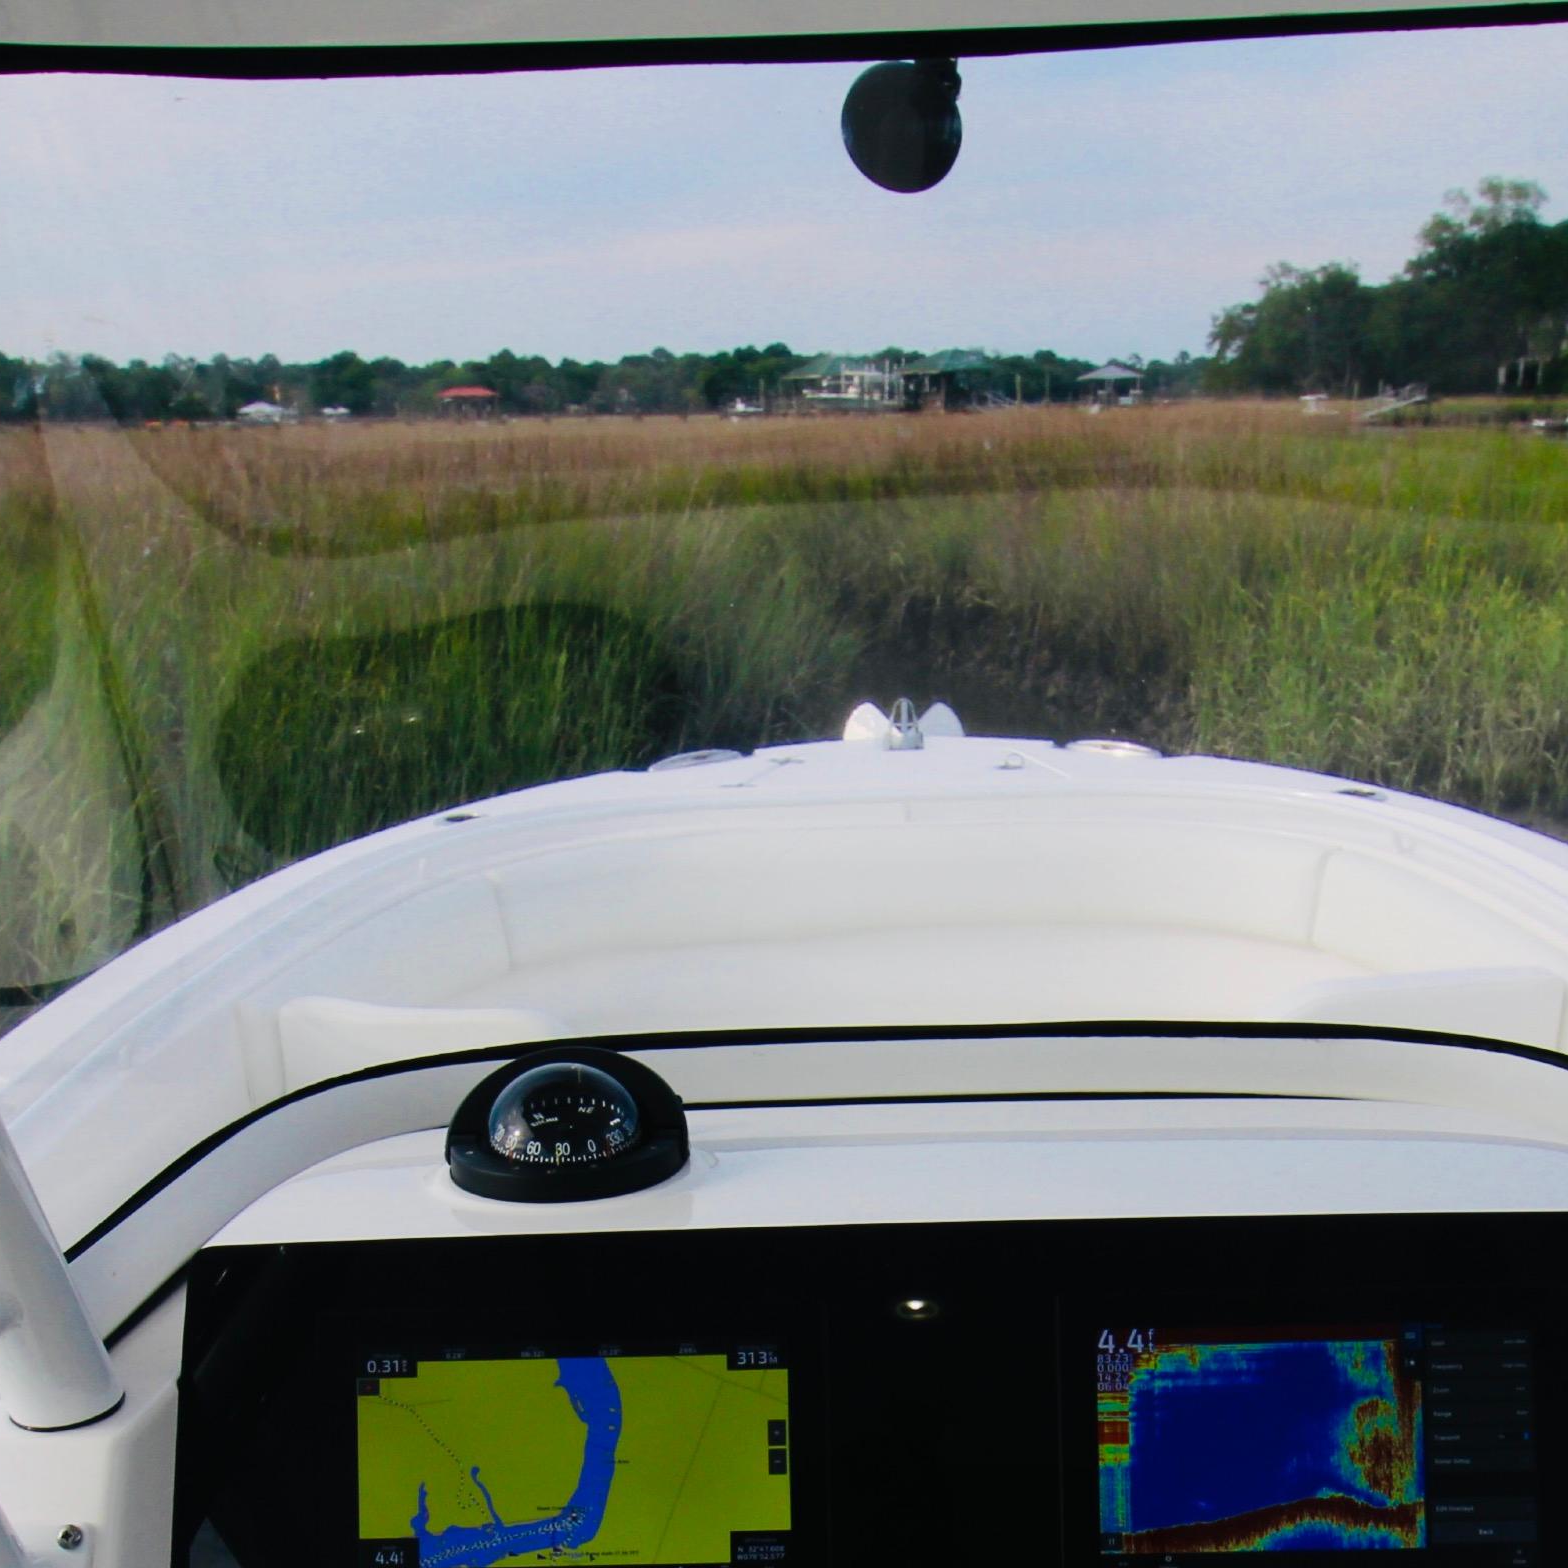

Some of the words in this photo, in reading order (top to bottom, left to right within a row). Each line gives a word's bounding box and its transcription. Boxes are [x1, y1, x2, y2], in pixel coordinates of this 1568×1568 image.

[577, 1106, 595, 1115] NE
[526, 1140, 542, 1156] 60
[555, 1141, 571, 1157] 30
[587, 1138, 597, 1153] 0
[1096, 1328, 1144, 1353] 4.4
[736, 1350, 768, 1366] 313
[366, 1359, 400, 1374] 0.31
[375, 1552, 399, 1565] 4.4
